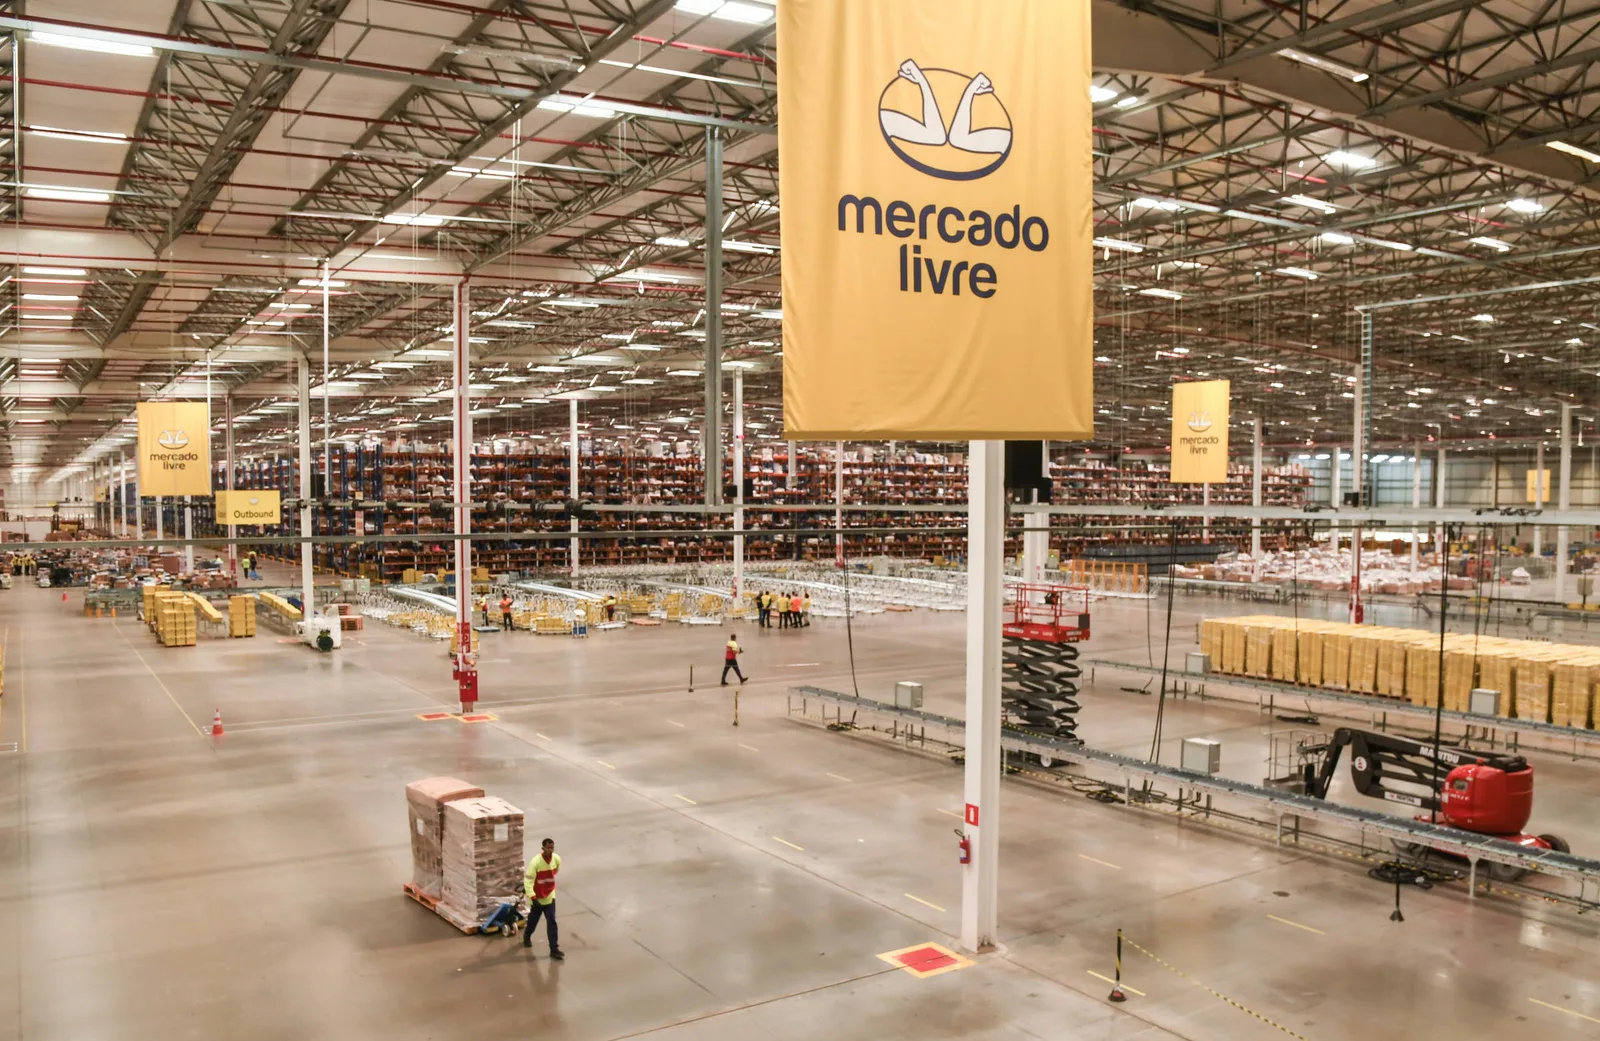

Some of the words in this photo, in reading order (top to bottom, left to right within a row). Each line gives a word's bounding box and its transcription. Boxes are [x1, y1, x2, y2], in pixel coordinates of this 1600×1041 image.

[837, 194, 1050, 252] mercado
[899, 243, 998, 299] livre
[1180, 436, 1218, 444] mercado
[1189, 445, 1208, 454] livre
[149, 451, 199, 461] mercado
[163, 461, 186, 470] livre
[233, 510, 274, 519] Outbound
